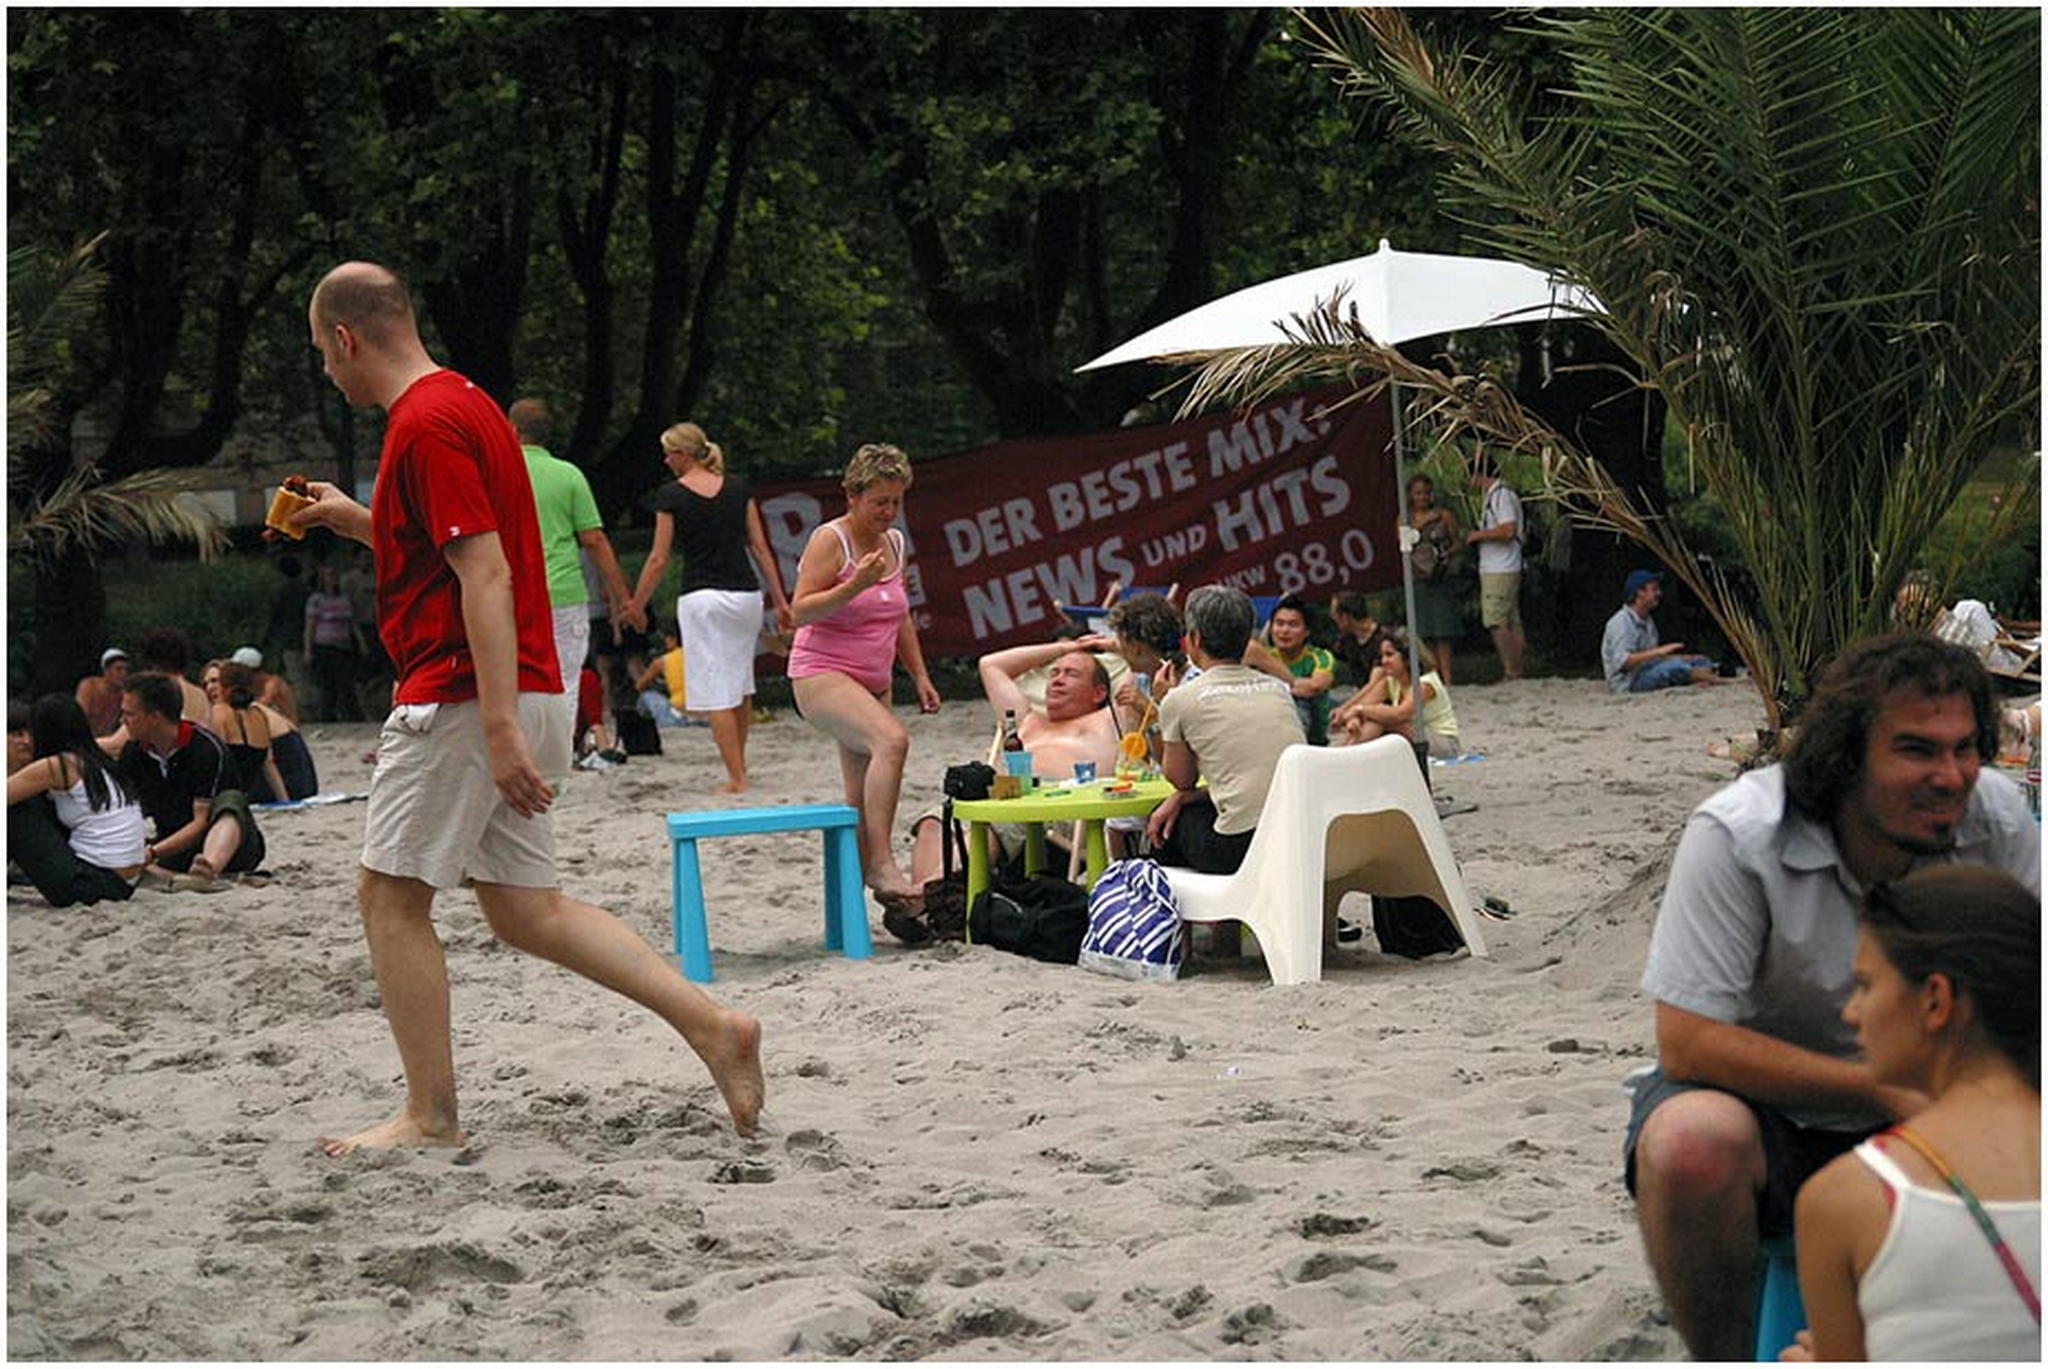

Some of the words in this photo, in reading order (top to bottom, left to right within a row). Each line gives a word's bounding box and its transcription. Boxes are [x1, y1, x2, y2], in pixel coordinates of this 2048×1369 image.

[944, 497, 1043, 567] DER
[1047, 442, 1196, 532] BESTE
[1207, 398, 1331, 478] MIX:
[962, 536, 1135, 640] NEWS
[1142, 524, 1206, 567] UND
[1212, 454, 1351, 552] HITS
[1274, 529, 1374, 594] 88,0
